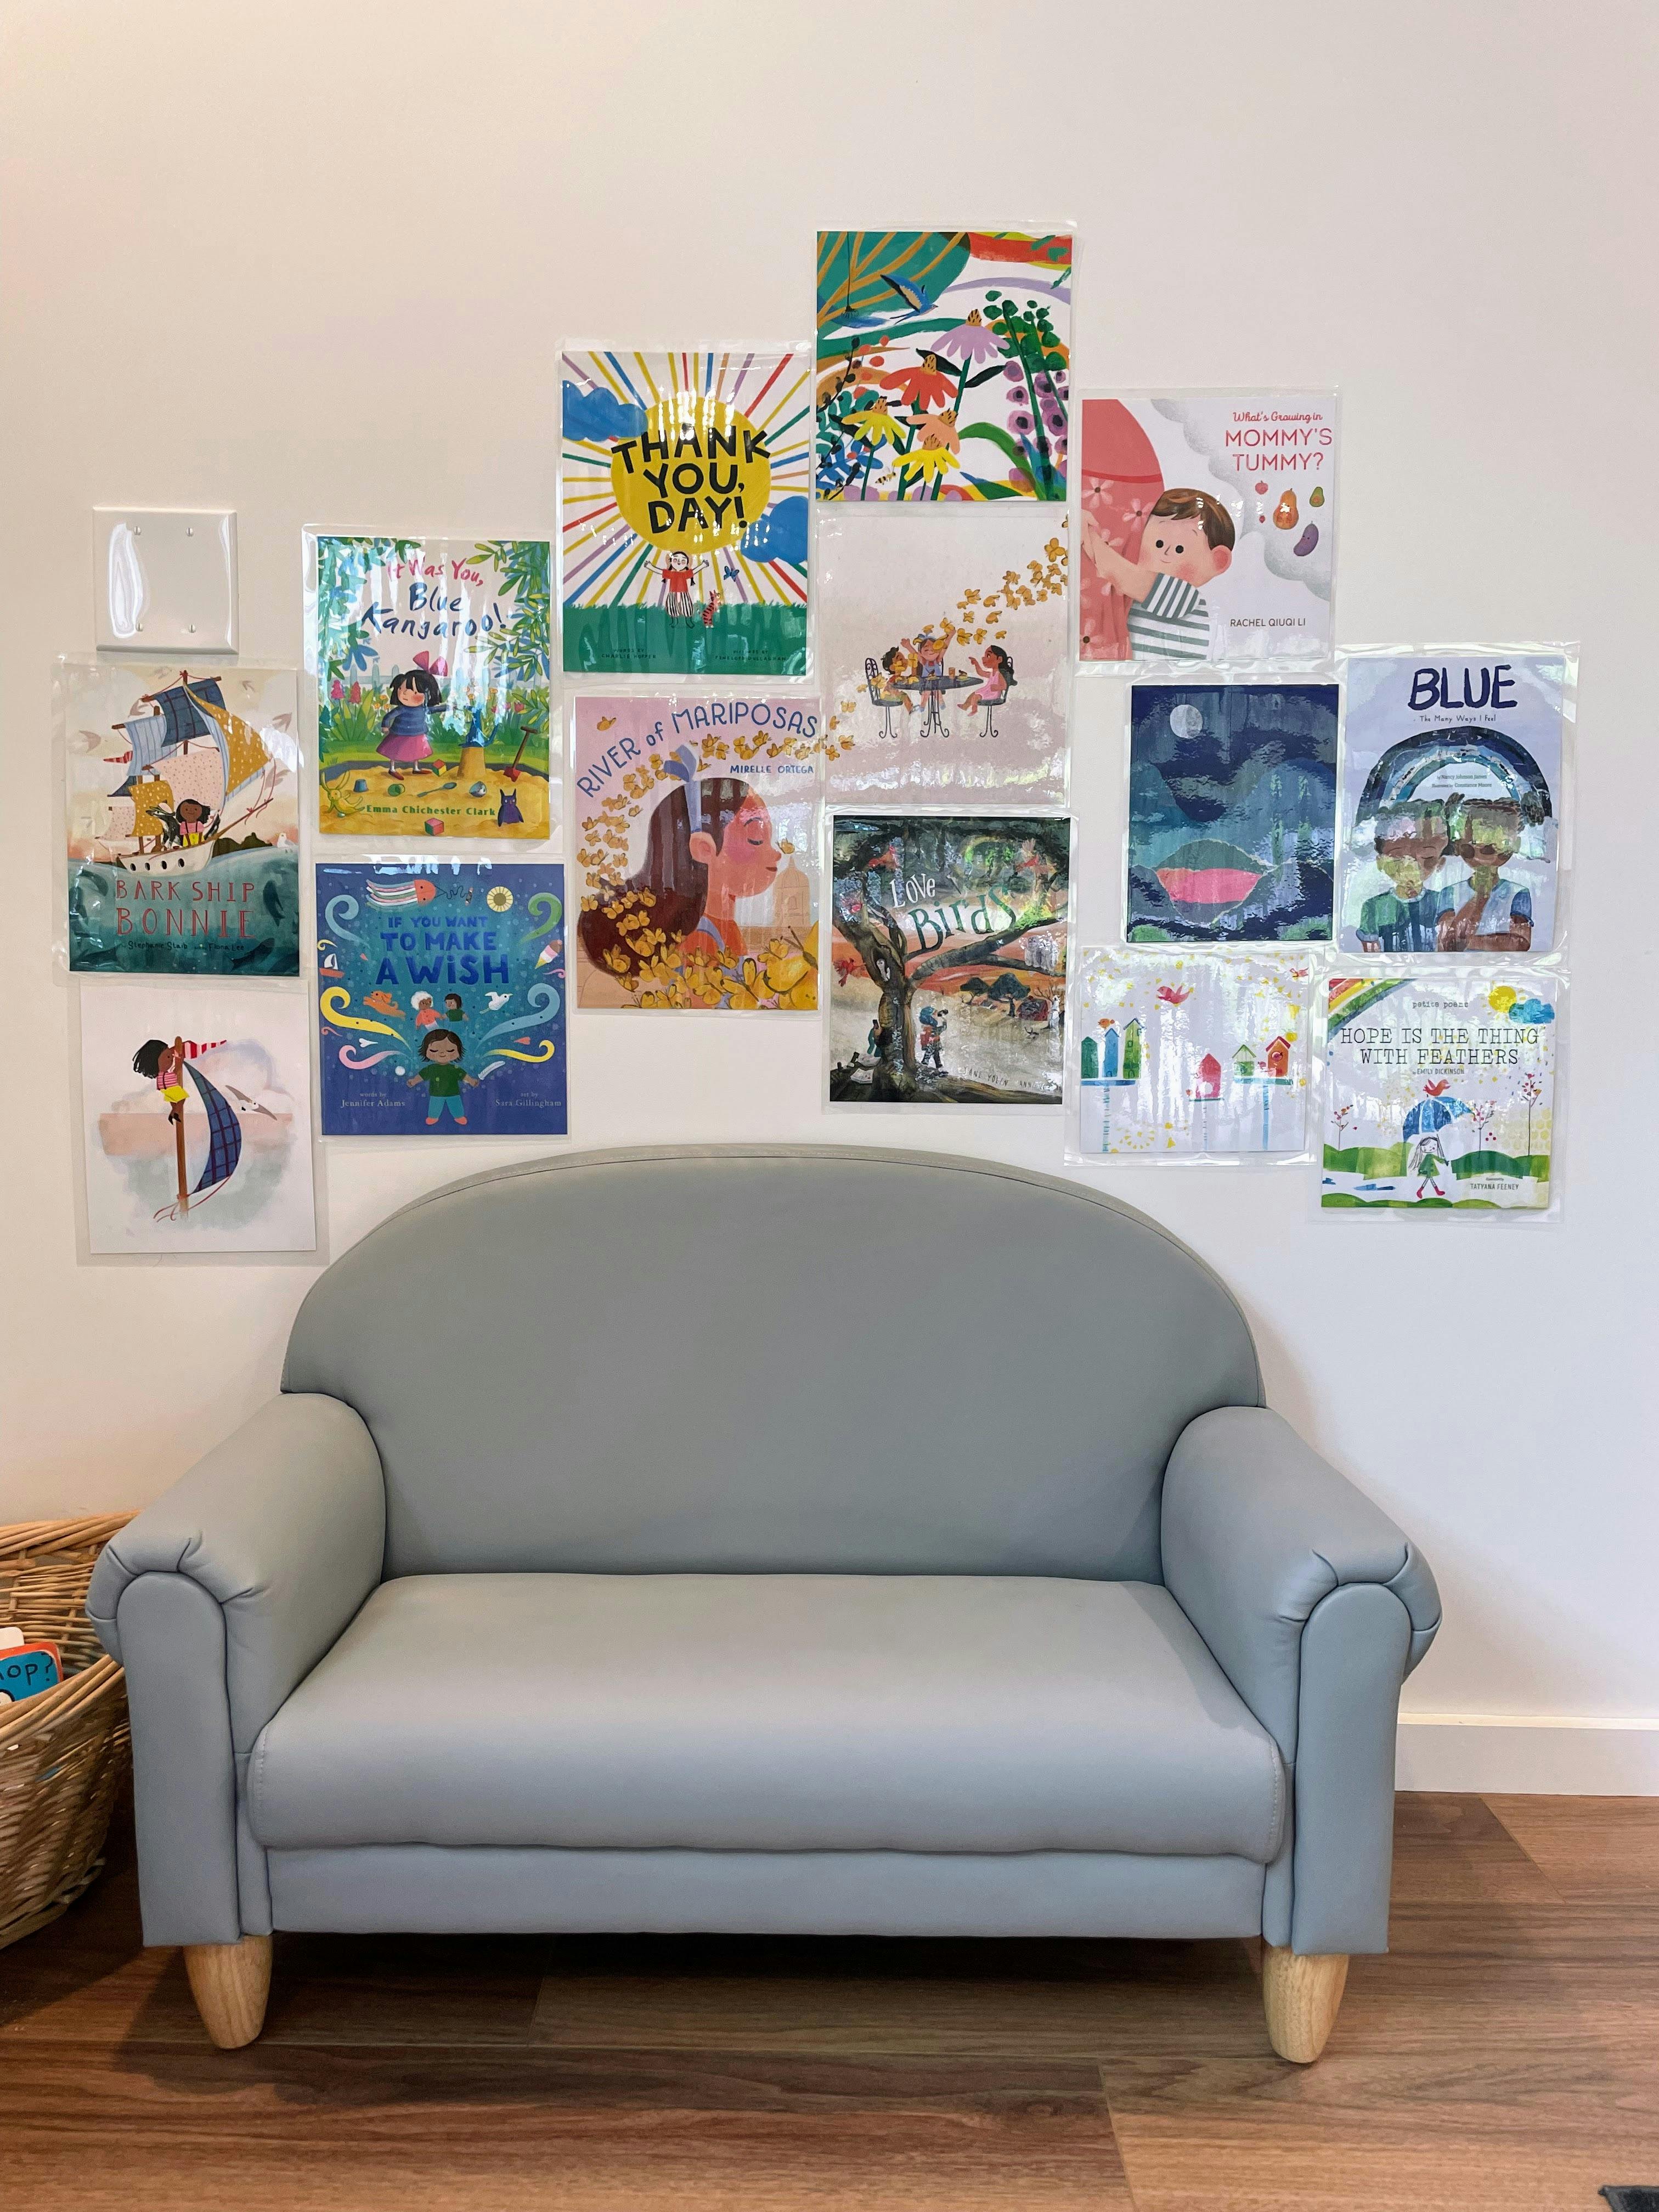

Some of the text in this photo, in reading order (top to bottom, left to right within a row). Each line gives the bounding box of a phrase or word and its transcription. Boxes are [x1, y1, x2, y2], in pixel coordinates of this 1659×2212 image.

[1233, 411, 1323, 424] What's Growing in
[1226, 428, 1333, 447] MOMMY'S
[611, 423, 771, 473] THANK
[1233, 452, 1324, 471] TUMMY?
[643, 462, 744, 498] YOU,
[648, 495, 747, 534] DAY!
[387, 556, 483, 586] It Was You,
[409, 582, 462, 612] Blue
[362, 601, 506, 640] Kangaroo!
[1230, 618, 1306, 627] RACHEL QIUQI LI
[1408, 664, 1517, 710] BLUE
[1434, 715, 1452, 724] Many
[1456, 715, 1476, 724] Ways
[577, 702, 817, 798] RIVER of MARIPOSAS
[730, 765, 814, 774] MIRELLE ORTEGA
[366, 805, 495, 816] Emma Chichester Clark
[116, 880, 255, 902] BARK SHIP
[116, 907, 255, 938] BONNIE
[388, 916, 488, 928] IF YOU WANT
[209, 943, 229, 951] Fiona
[380, 932, 496, 951] TO MAKE
[376, 957, 399, 985] A
[1341, 1028, 1539, 1044] HOPE IS THE THING
[1360, 1049, 1519, 1064] WITH FEATHERS
[963, 1066, 983, 1079] JANE
[341, 1099, 374, 1108] Jennifer
[515, 1099, 561, 1109] Gillingham
[0, 1651, 53, 1685] OP?
